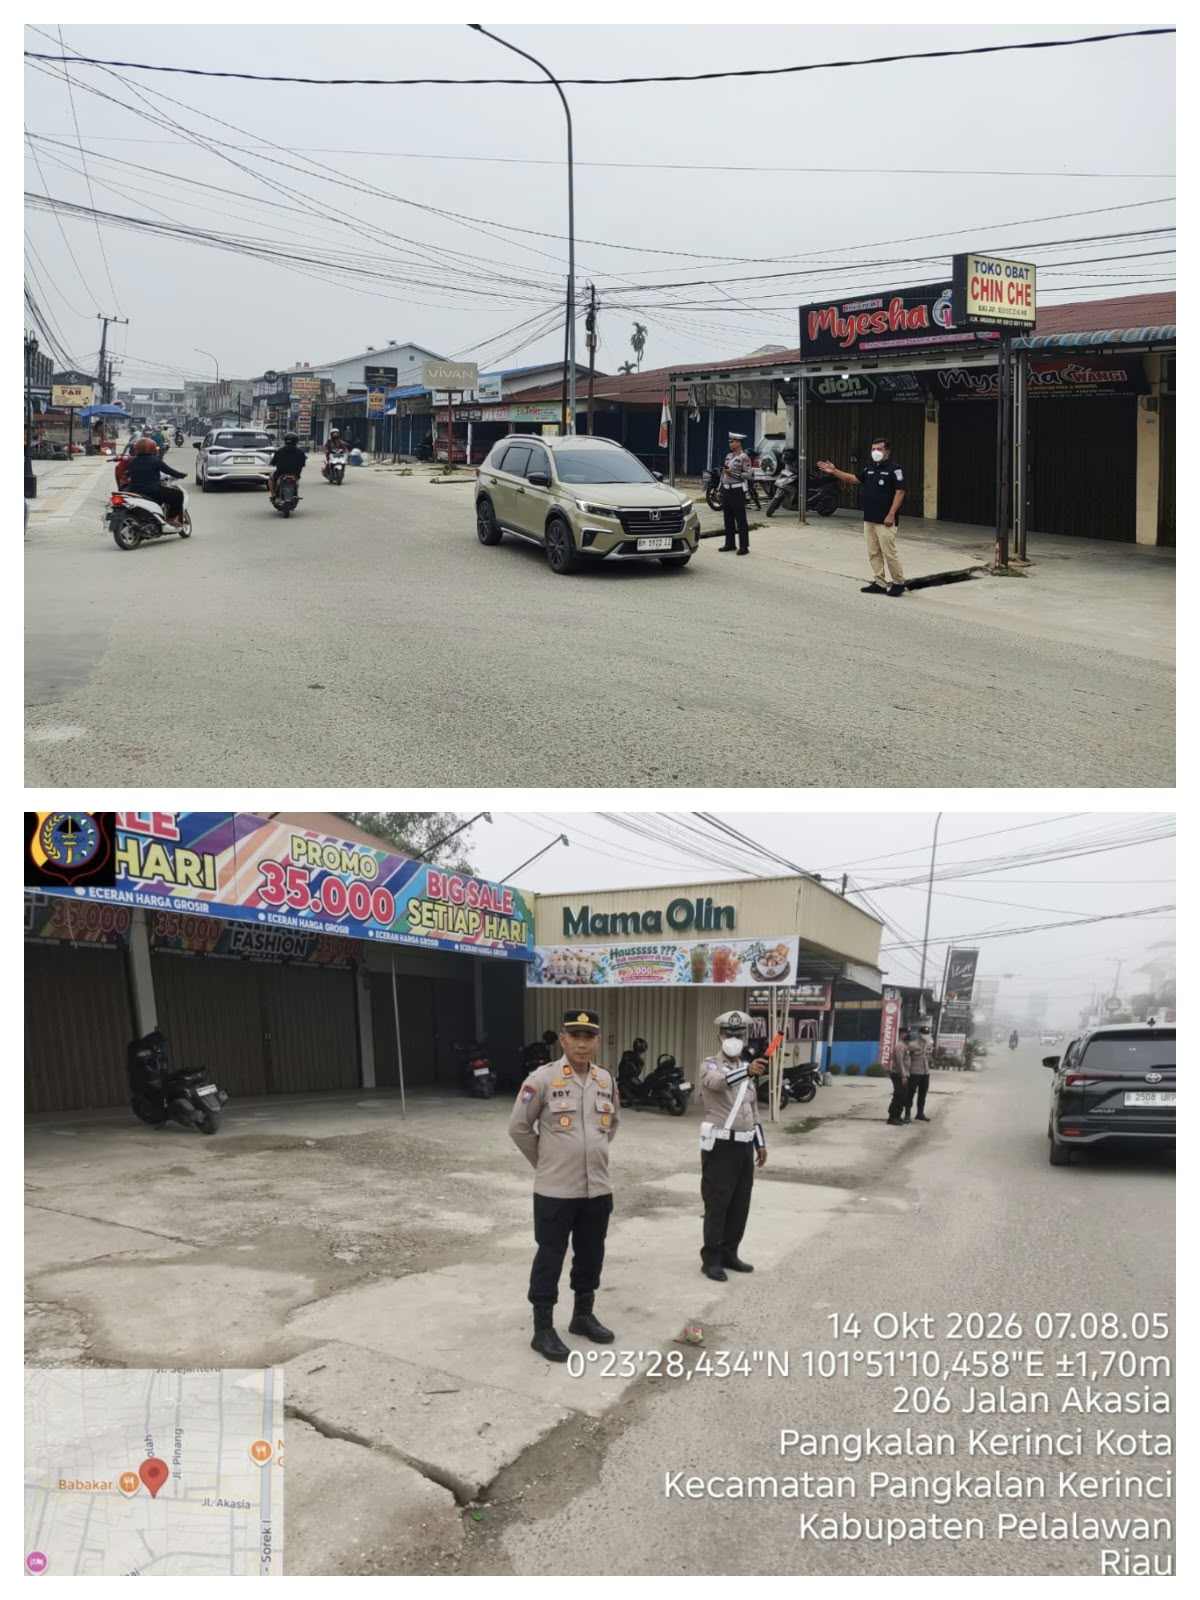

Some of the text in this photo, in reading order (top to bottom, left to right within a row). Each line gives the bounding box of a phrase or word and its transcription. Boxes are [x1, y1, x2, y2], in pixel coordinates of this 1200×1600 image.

[973, 260, 1030, 280] TOKO OBAT
[970, 277, 1032, 307] CHIN CHE
[808, 297, 929, 347] Myesha
[818, 375, 861, 395] dion
[1073, 370, 1128, 381] WANGI
[291, 835, 377, 880] PROMO
[89, 886, 209, 914] ECERAN HARGA GROSIR
[258, 860, 395, 925] 35.000
[426, 870, 513, 915] BIG SALE
[52, 901, 130, 934] 35.000
[154, 910, 222, 940] 35.000
[267, 913, 299, 926] ECERAN
[300, 918, 324, 931] HARGA
[324, 922, 349, 935] GROSIR
[407, 898, 528, 944] SETIAP HARI
[563, 898, 735, 937] Mama Olin
[231, 928, 307, 957] FASHION
[375, 930, 439, 948] ECERAN HARGA GROSIR
[459, 943, 479, 953] ECERAN
[479, 946, 493, 955] HARGA
[660, 945, 677, 956] ???
